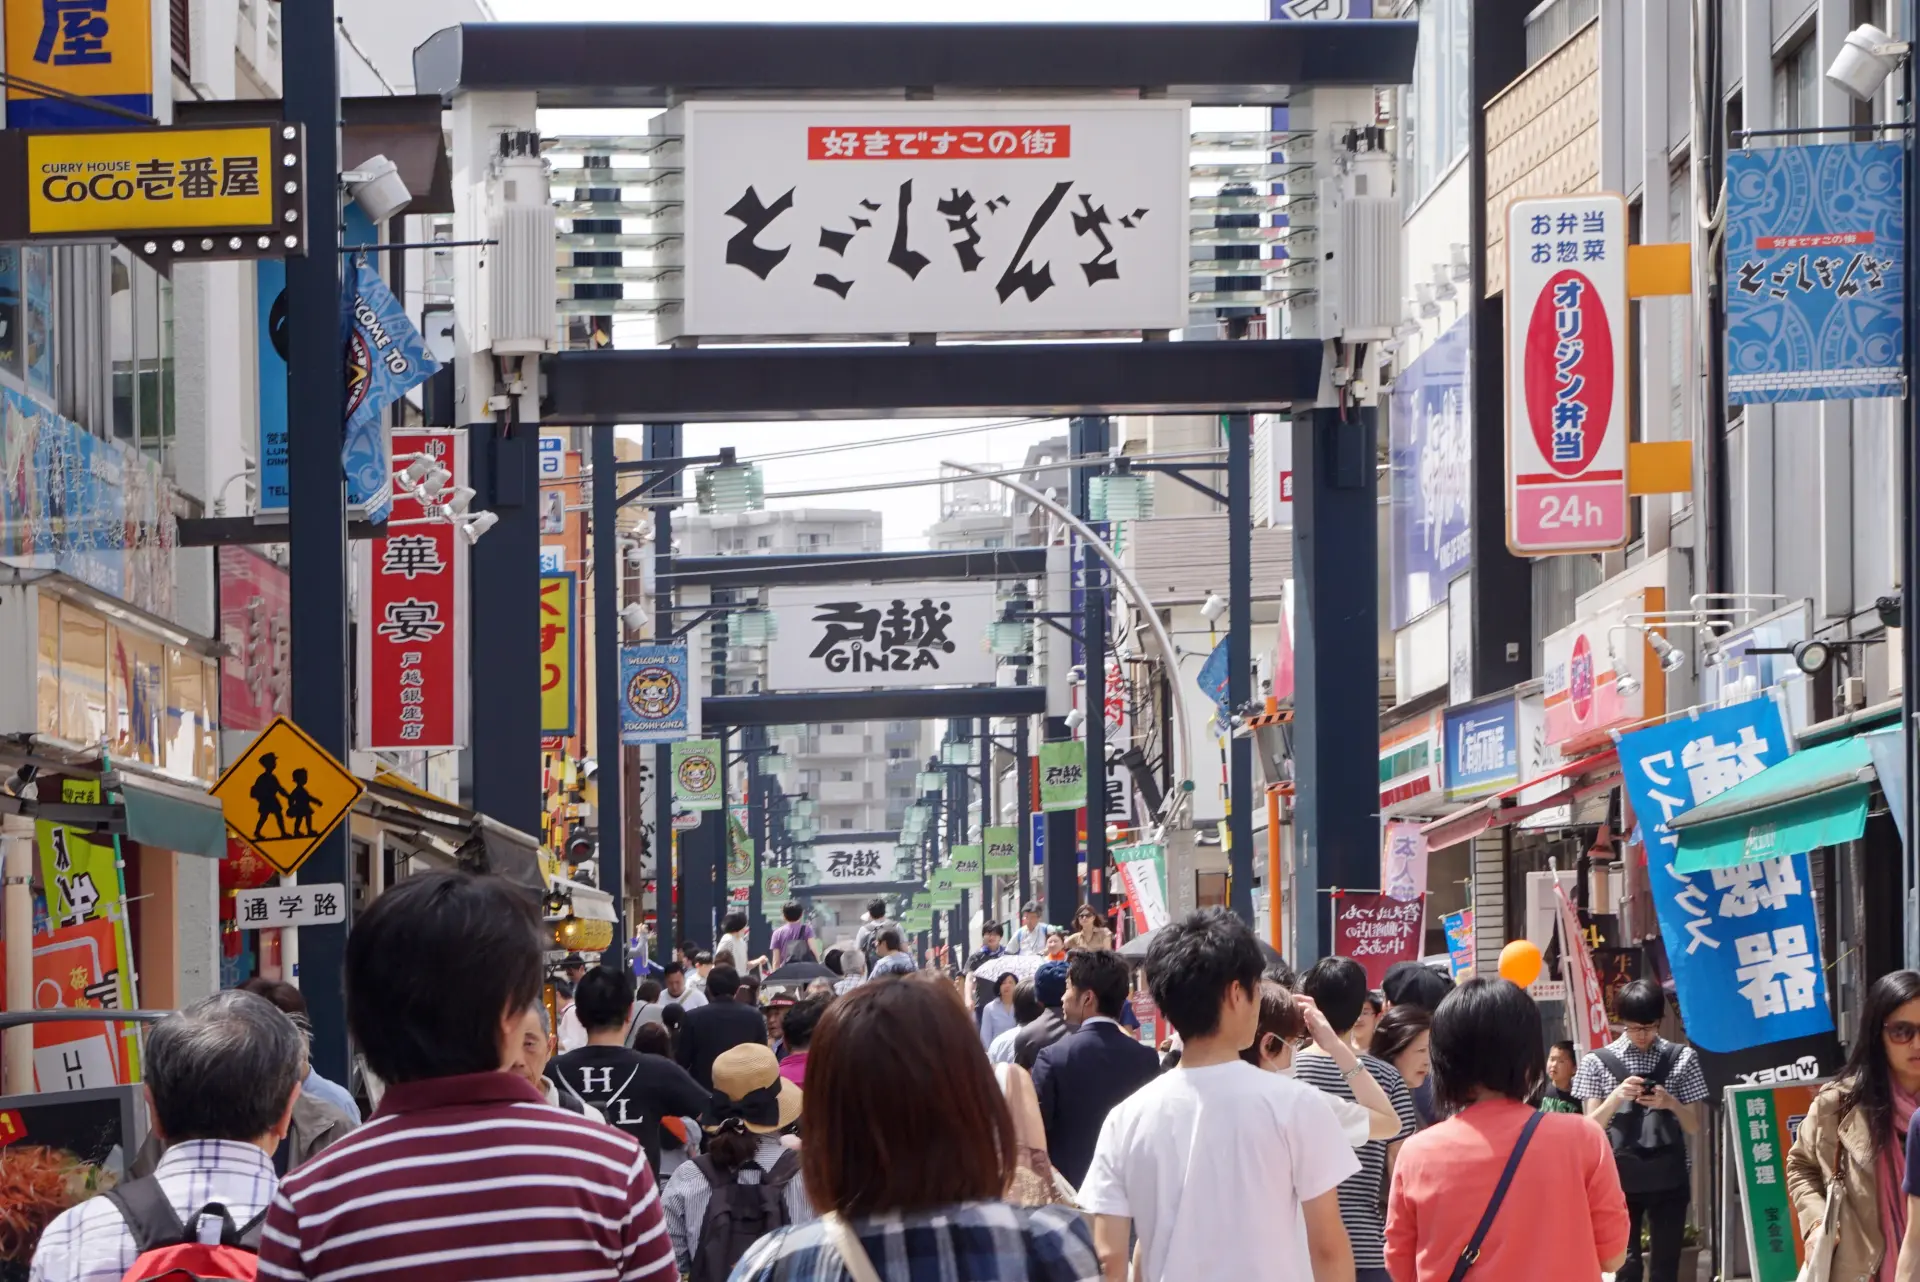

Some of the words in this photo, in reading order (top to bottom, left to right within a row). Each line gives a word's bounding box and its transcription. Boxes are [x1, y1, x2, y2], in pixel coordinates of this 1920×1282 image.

[822, 129, 1057, 157] 好きですこの街
[41, 162, 83, 173] CURRY
[86, 160, 131, 172] HOUSE
[1531, 210, 1605, 235] お弁当
[725, 177, 1150, 306] とごしぎんざ
[1531, 239, 1605, 264] お惣菜
[1773, 234, 1857, 248] 好きですこの街
[1736, 251, 1893, 300] とごしぎんざ
[384, 347, 408, 375] TO
[1552, 279, 1586, 463] オリジン弁当
[1539, 495, 1603, 529] 24h
[627, 656, 665, 665] WELCOME
[667, 655, 680, 664] TO
[825, 641, 940, 673] GINZA
[400, 652, 424, 740] 戸越銀座店
[832, 865, 876, 877] GINZA
[244, 893, 337, 922] 通学路
[579, 1066, 614, 1093] H
[615, 1099, 643, 1125] L
[1746, 1096, 1776, 1184] 時計修理
